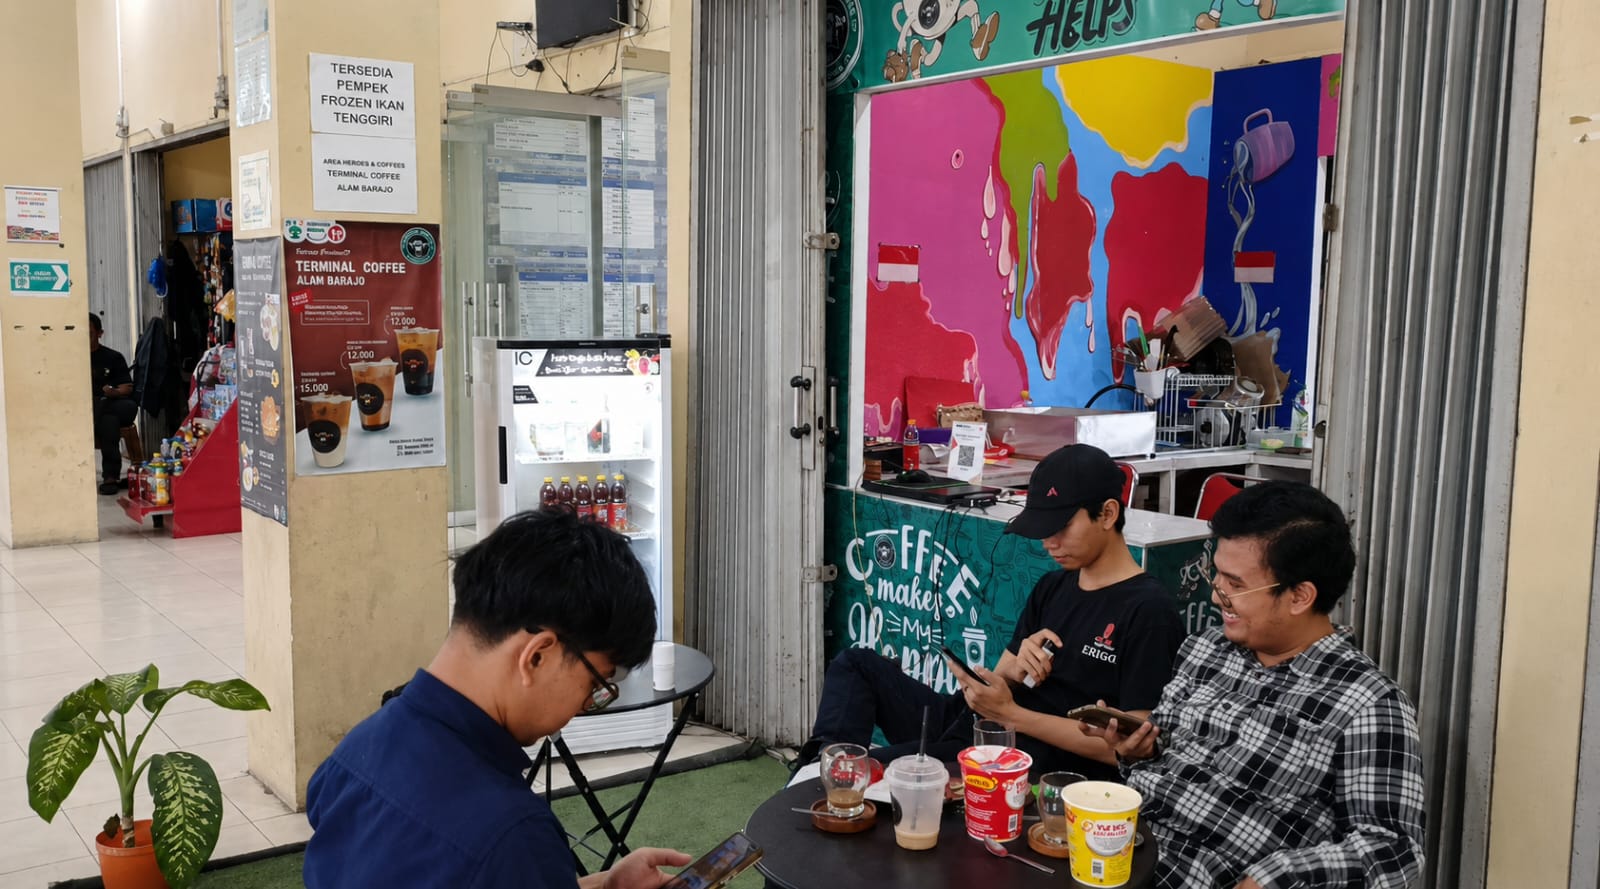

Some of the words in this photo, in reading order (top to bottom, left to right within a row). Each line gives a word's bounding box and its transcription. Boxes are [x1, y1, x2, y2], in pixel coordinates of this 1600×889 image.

[330, 62, 393, 79] TERSEDIA
[337, 79, 389, 94] PEMPEK
[321, 94, 372, 108] FROZEN
[376, 99, 404, 111] IKAN
[333, 111, 393, 126] TENGGIRI
[323, 158, 342, 166] AREA
[327, 169, 369, 179] TERMINAL
[370, 172, 401, 181] COFFEE
[337, 183, 360, 192] ALAM
[361, 184, 394, 193] BARAJO
[295, 260, 356, 273] TERMINAL
[363, 261, 406, 274] COFFEE
[296, 274, 325, 286] ALAM
[327, 275, 366, 286] BARAJO
[390, 316, 416, 326] 12.000
[348, 350, 375, 360] 12.000
[300, 383, 329, 393] 15.000
[902, 615, 932, 650] My
